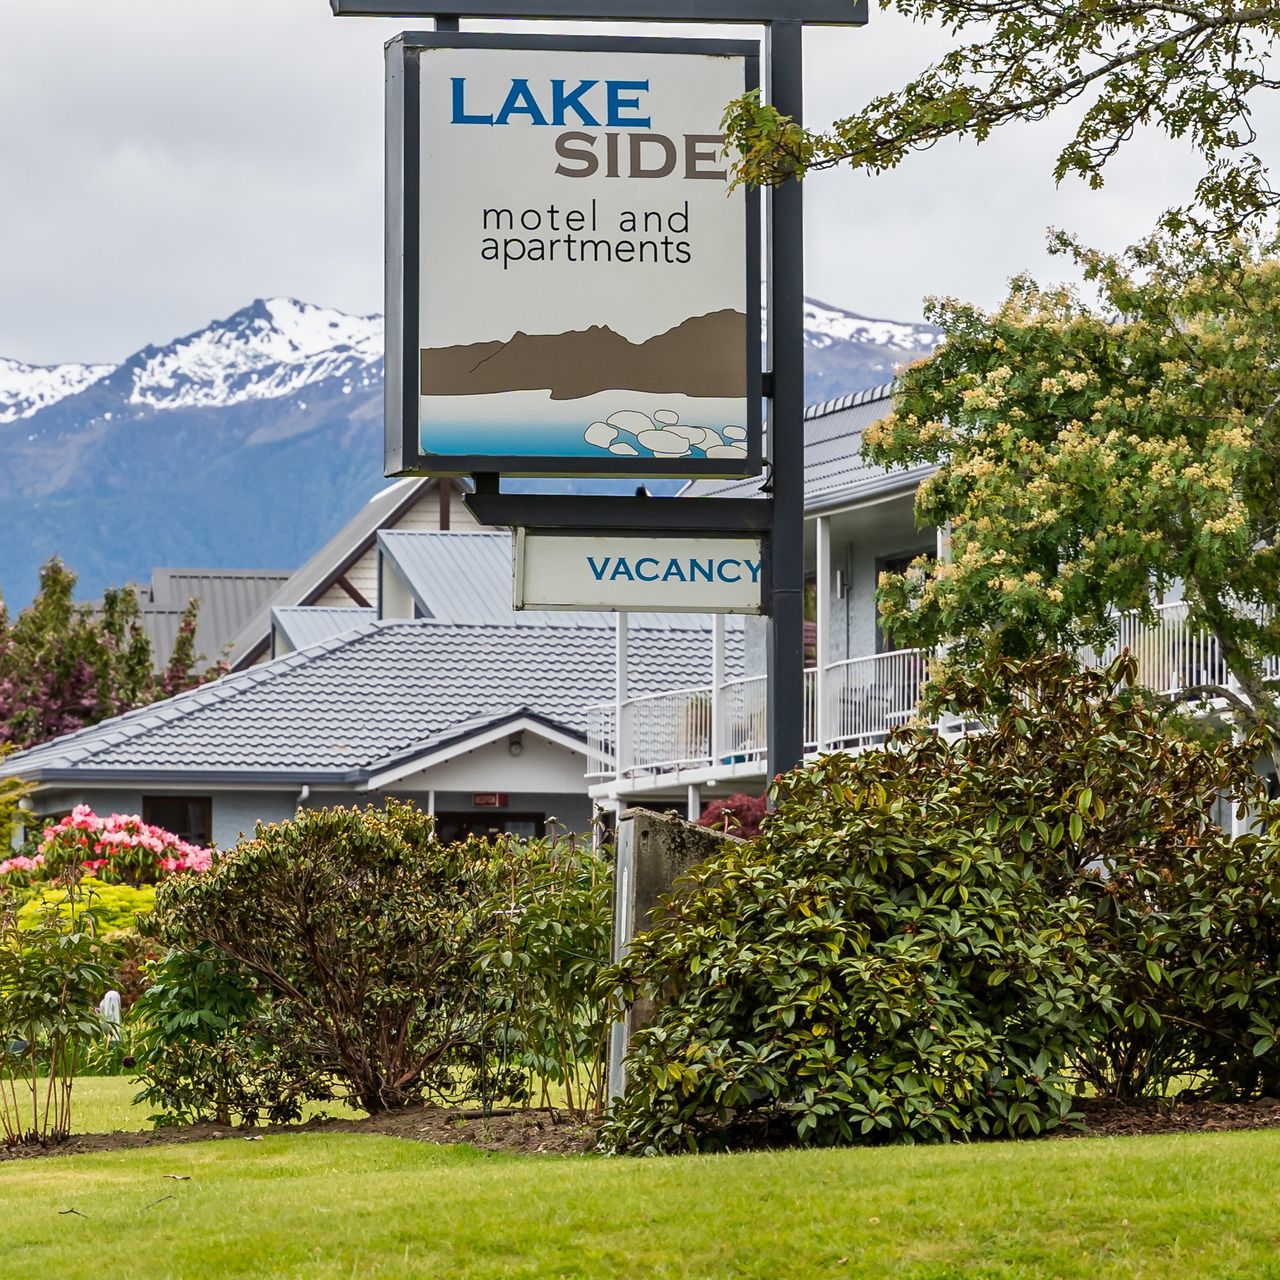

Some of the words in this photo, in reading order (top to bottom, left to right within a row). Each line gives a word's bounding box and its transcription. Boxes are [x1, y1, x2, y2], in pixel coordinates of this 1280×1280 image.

[450, 77, 651, 129] LAKE
[554, 131, 728, 182] SIDE
[482, 199, 597, 232] motel
[619, 200, 689, 233] and
[480, 232, 692, 270] apartments
[586, 557, 761, 583] VACANCY
